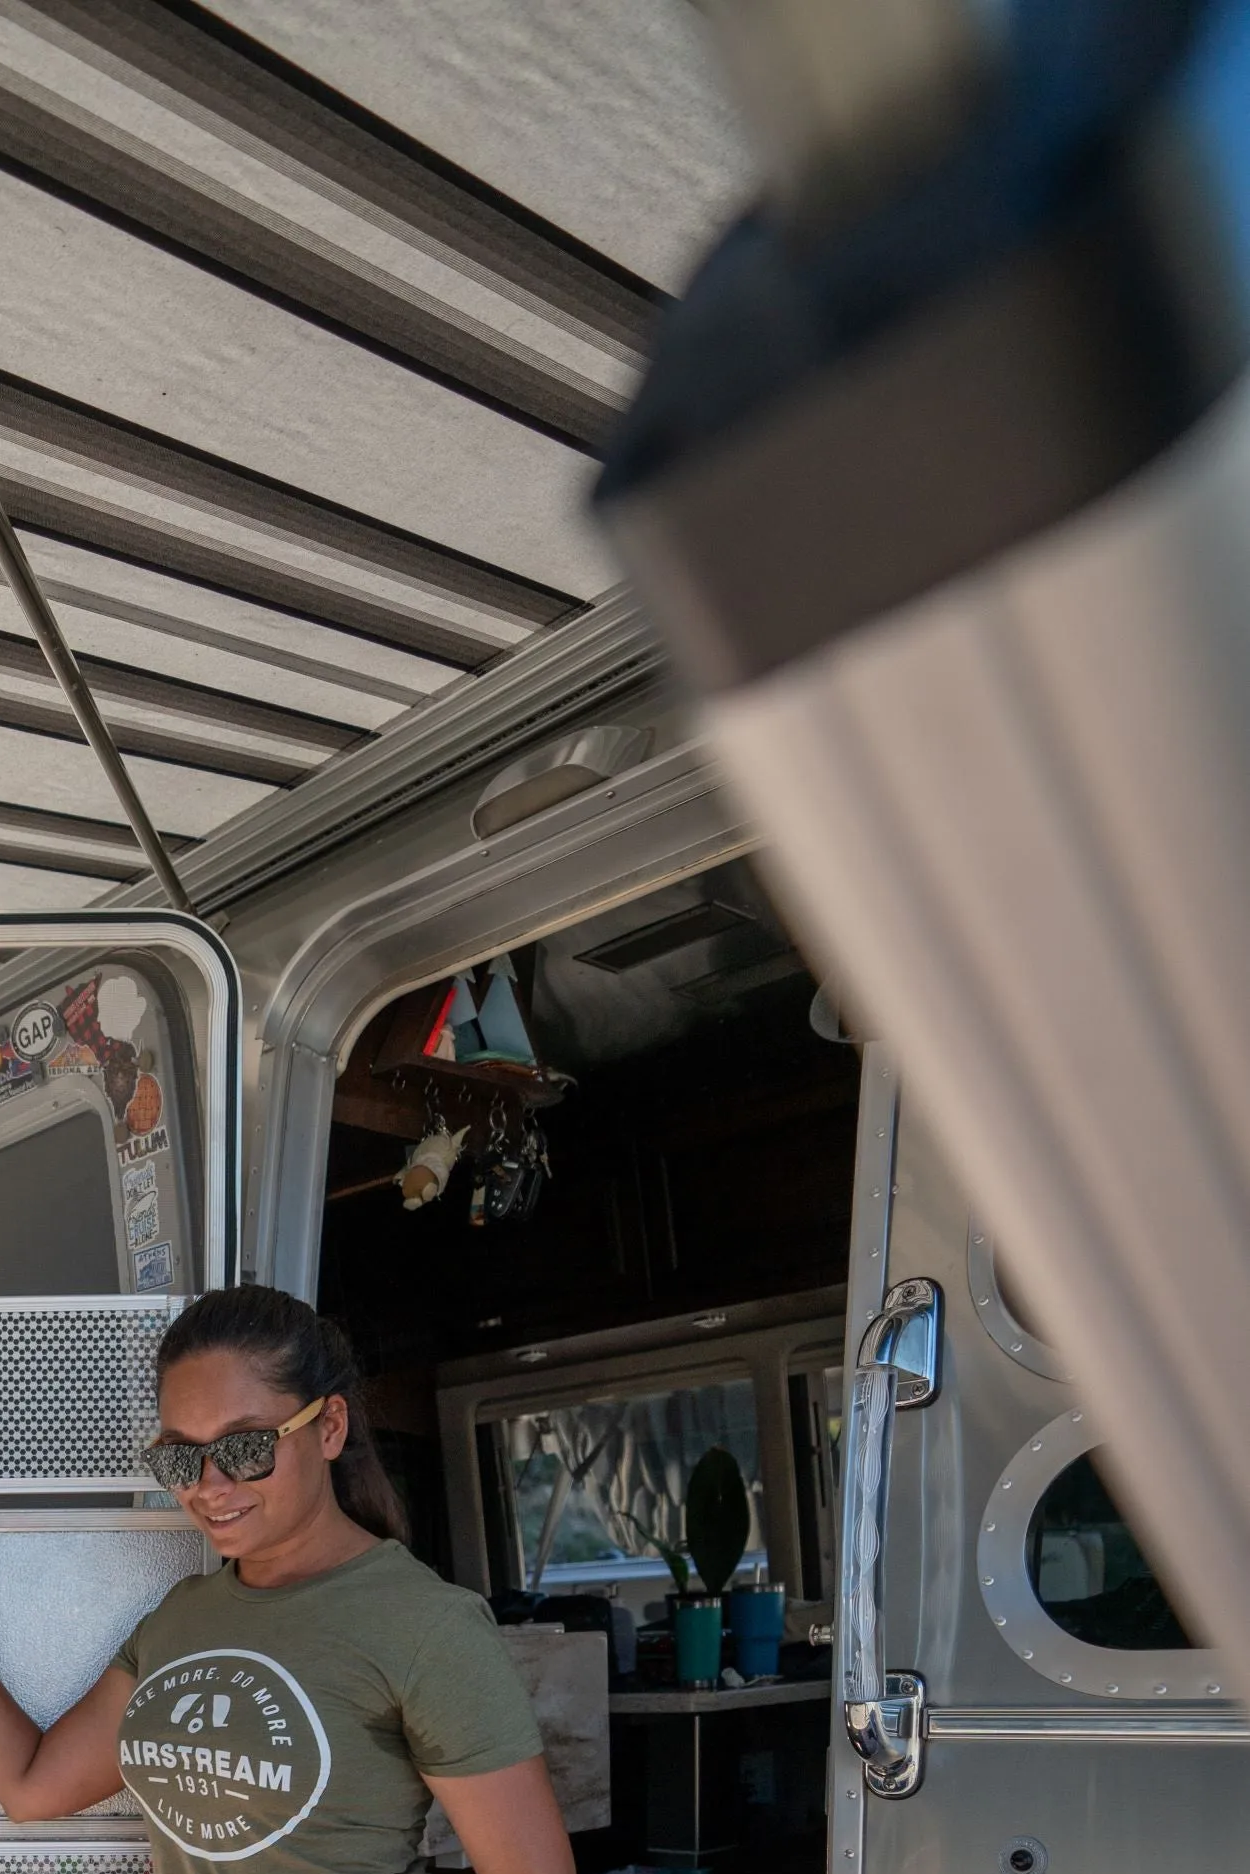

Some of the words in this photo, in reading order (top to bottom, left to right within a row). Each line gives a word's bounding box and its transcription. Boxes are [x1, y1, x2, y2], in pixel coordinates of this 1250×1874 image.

[18, 1016, 51, 1048] GAP
[117, 1129, 168, 1165] TULUM
[143, 1177, 154, 1190] LET
[126, 1688, 156, 1718] SEE
[163, 1667, 221, 1692] MORE.
[231, 1671, 254, 1688] DO
[252, 1687, 293, 1747] MORE
[120, 1740, 292, 1792] AIRSTREAM
[175, 1774, 218, 1798] 1931
[158, 1799, 193, 1834] LIVE
[201, 1815, 251, 1839] MORE
